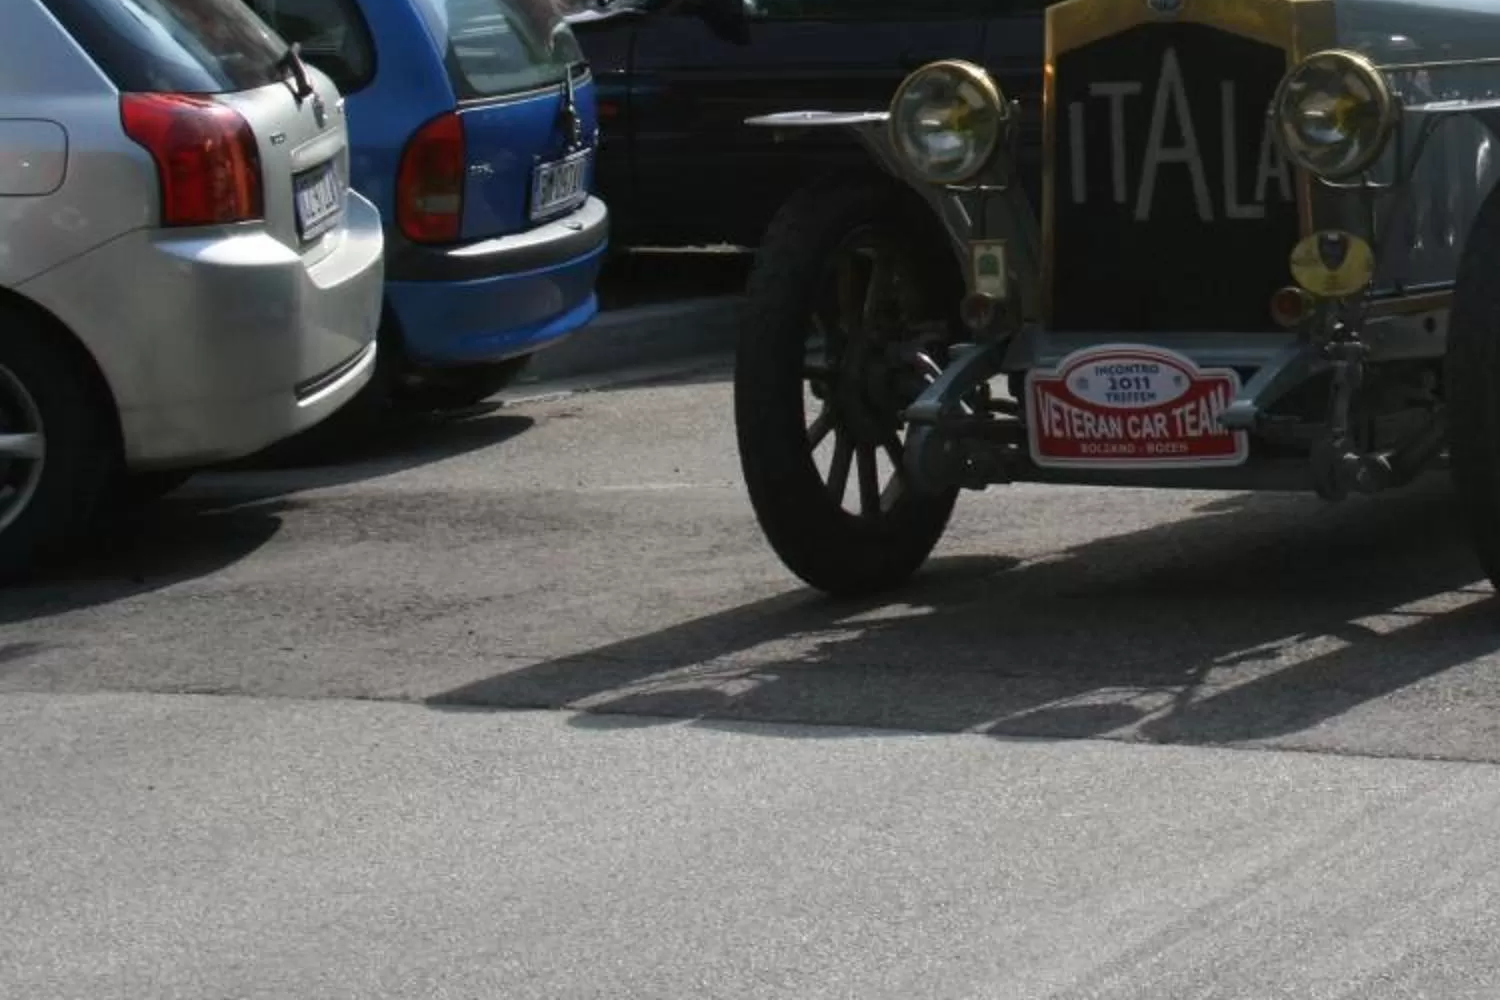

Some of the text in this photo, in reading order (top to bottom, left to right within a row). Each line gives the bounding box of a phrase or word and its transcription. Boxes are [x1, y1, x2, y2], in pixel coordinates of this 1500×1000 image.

[1094, 363, 1160, 376] INCONTRO
[1107, 375, 1151, 390] 2011
[1036, 383, 1123, 440] VETERAN
[1127, 413, 1169, 439] CAR
